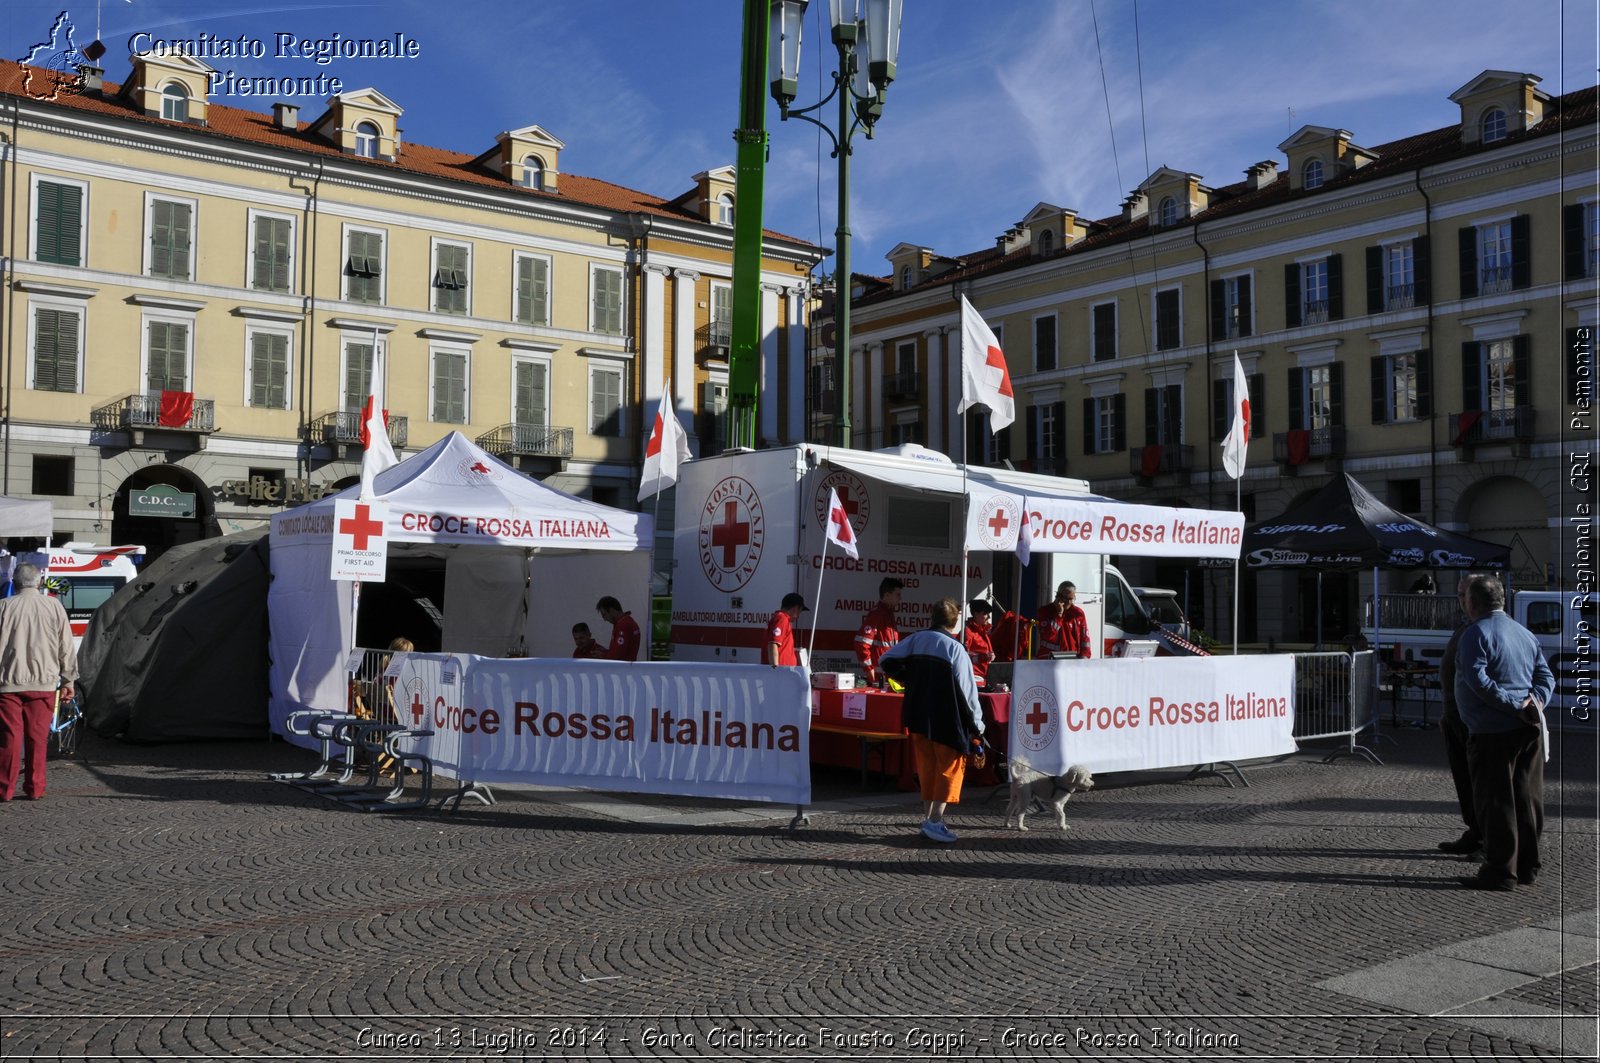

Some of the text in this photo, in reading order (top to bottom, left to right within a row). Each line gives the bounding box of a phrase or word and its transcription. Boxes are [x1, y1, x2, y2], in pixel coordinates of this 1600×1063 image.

[138, 495, 176, 506] C.D.C.
[278, 516, 301, 537] COMITATO
[401, 512, 610, 539] CROCE ROSSA ITALIANA
[706, 480, 763, 584] ROSSA ITALIANA
[1030, 511, 1092, 541] Croce
[1099, 515, 1164, 543] Rossa
[1171, 519, 1240, 544] Italiana
[1254, 523, 1347, 535] Sifam.fr
[337, 549, 382, 558] PRIMO SOCCORSO
[344, 558, 362, 566] FIRST
[701, 527, 723, 585] CROCE
[1274, 551, 1308, 562] Sifam
[812, 555, 864, 572] CROCE
[868, 559, 917, 575] ROSSA
[672, 611, 716, 622] AMBULATORIO
[717, 612, 741, 623] MOBILE
[1066, 692, 1287, 732] Croce Rossa Italiana
[434, 695, 500, 735] Croce
[514, 701, 635, 747] Rossa
[650, 707, 800, 757] Italiana
